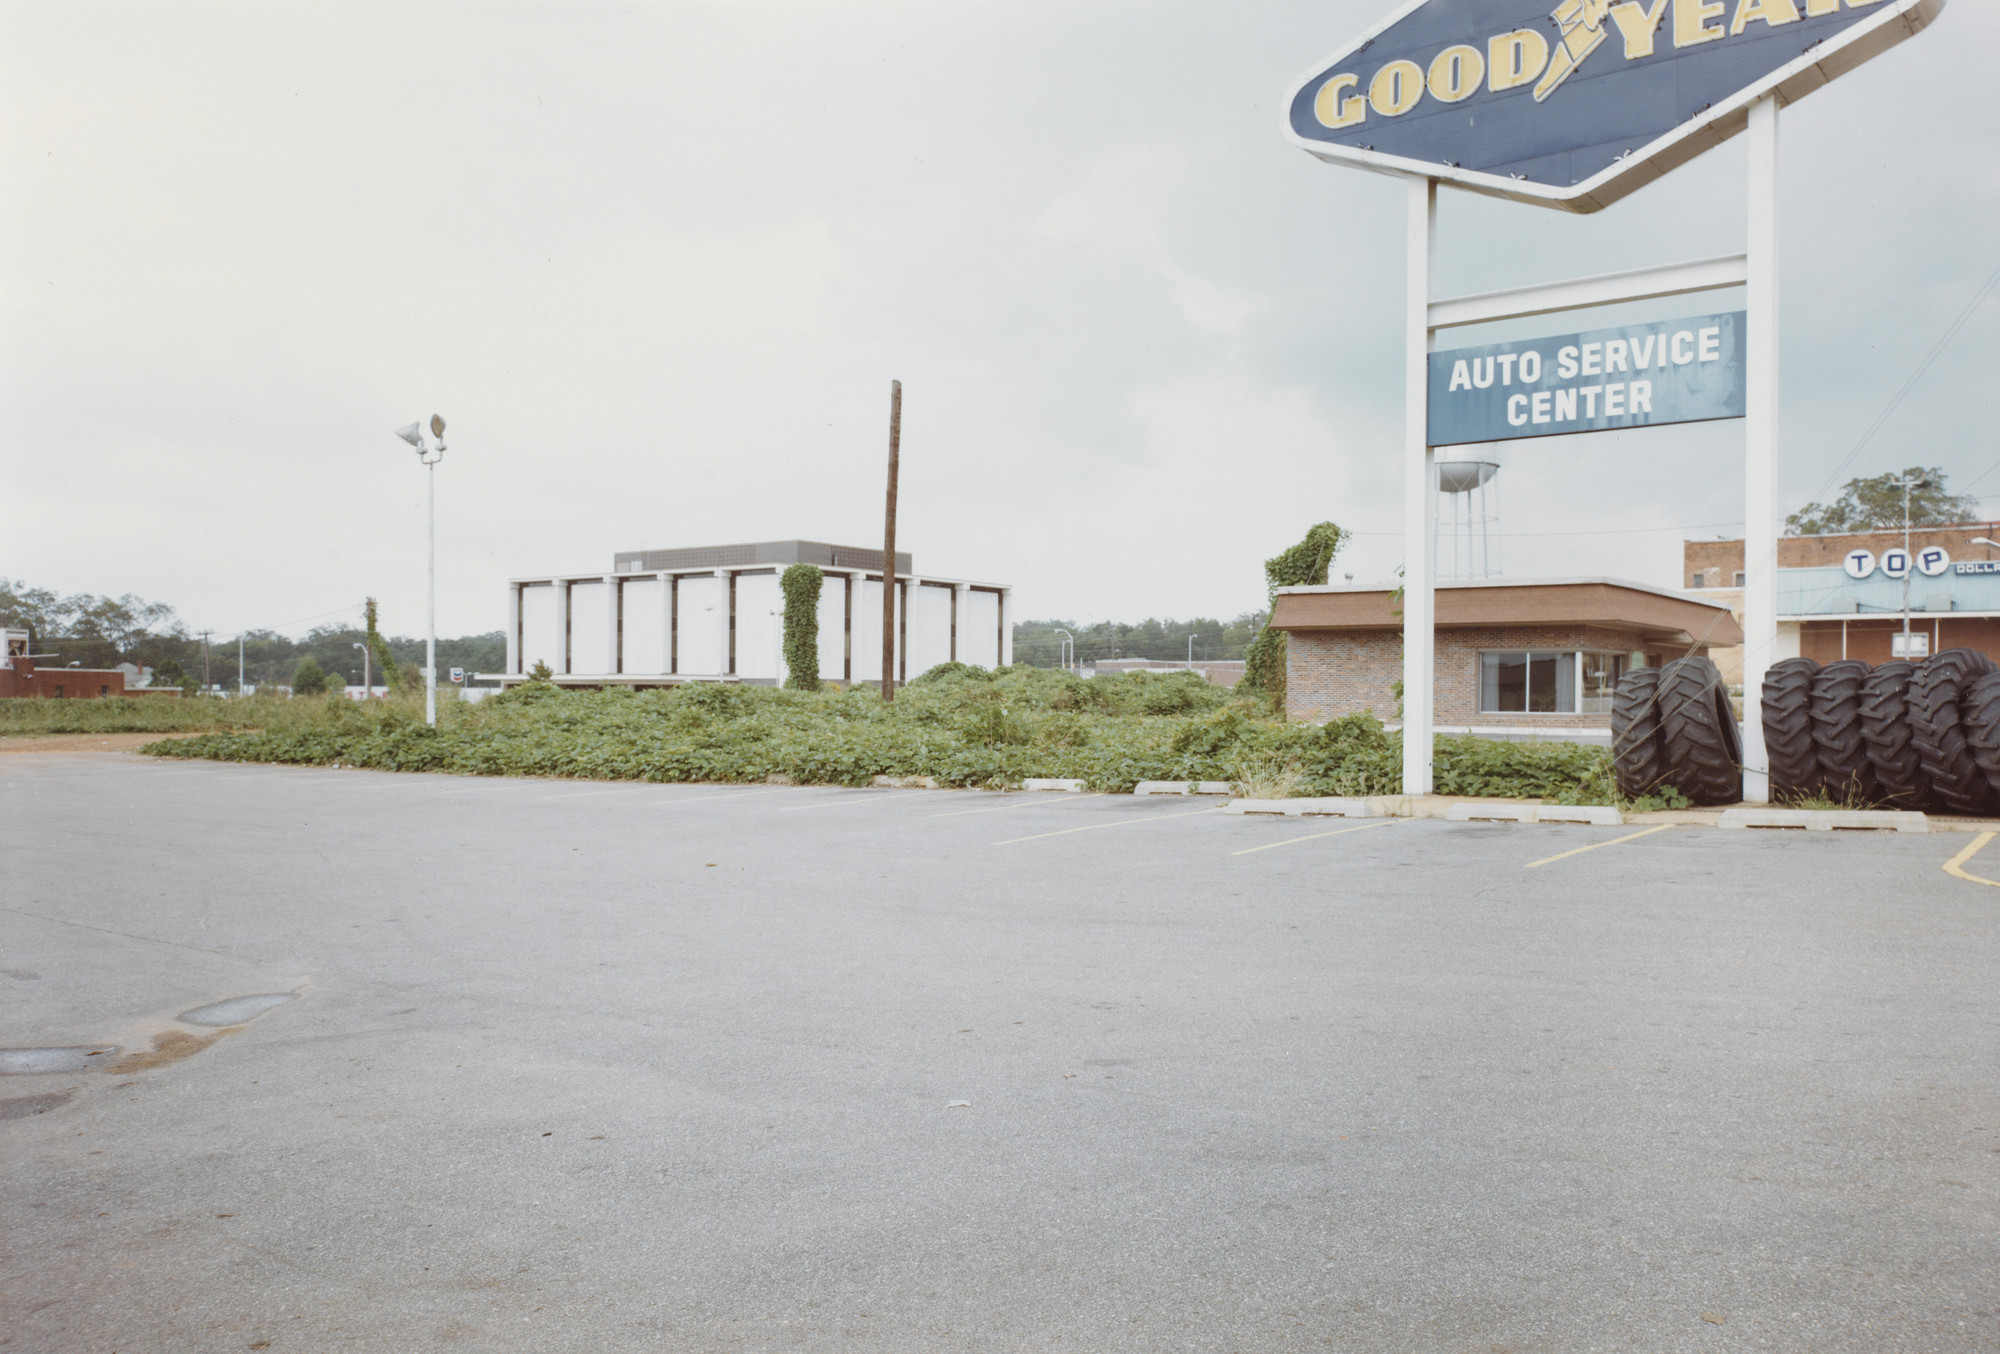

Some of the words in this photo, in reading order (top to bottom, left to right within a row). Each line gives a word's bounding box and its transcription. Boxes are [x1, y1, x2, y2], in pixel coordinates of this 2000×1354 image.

[1449, 350, 1541, 392] AUTO
[1557, 326, 1720, 379] SERVICE
[1507, 379, 1652, 426] CENTER
[1851, 551, 1942, 573] TOP
